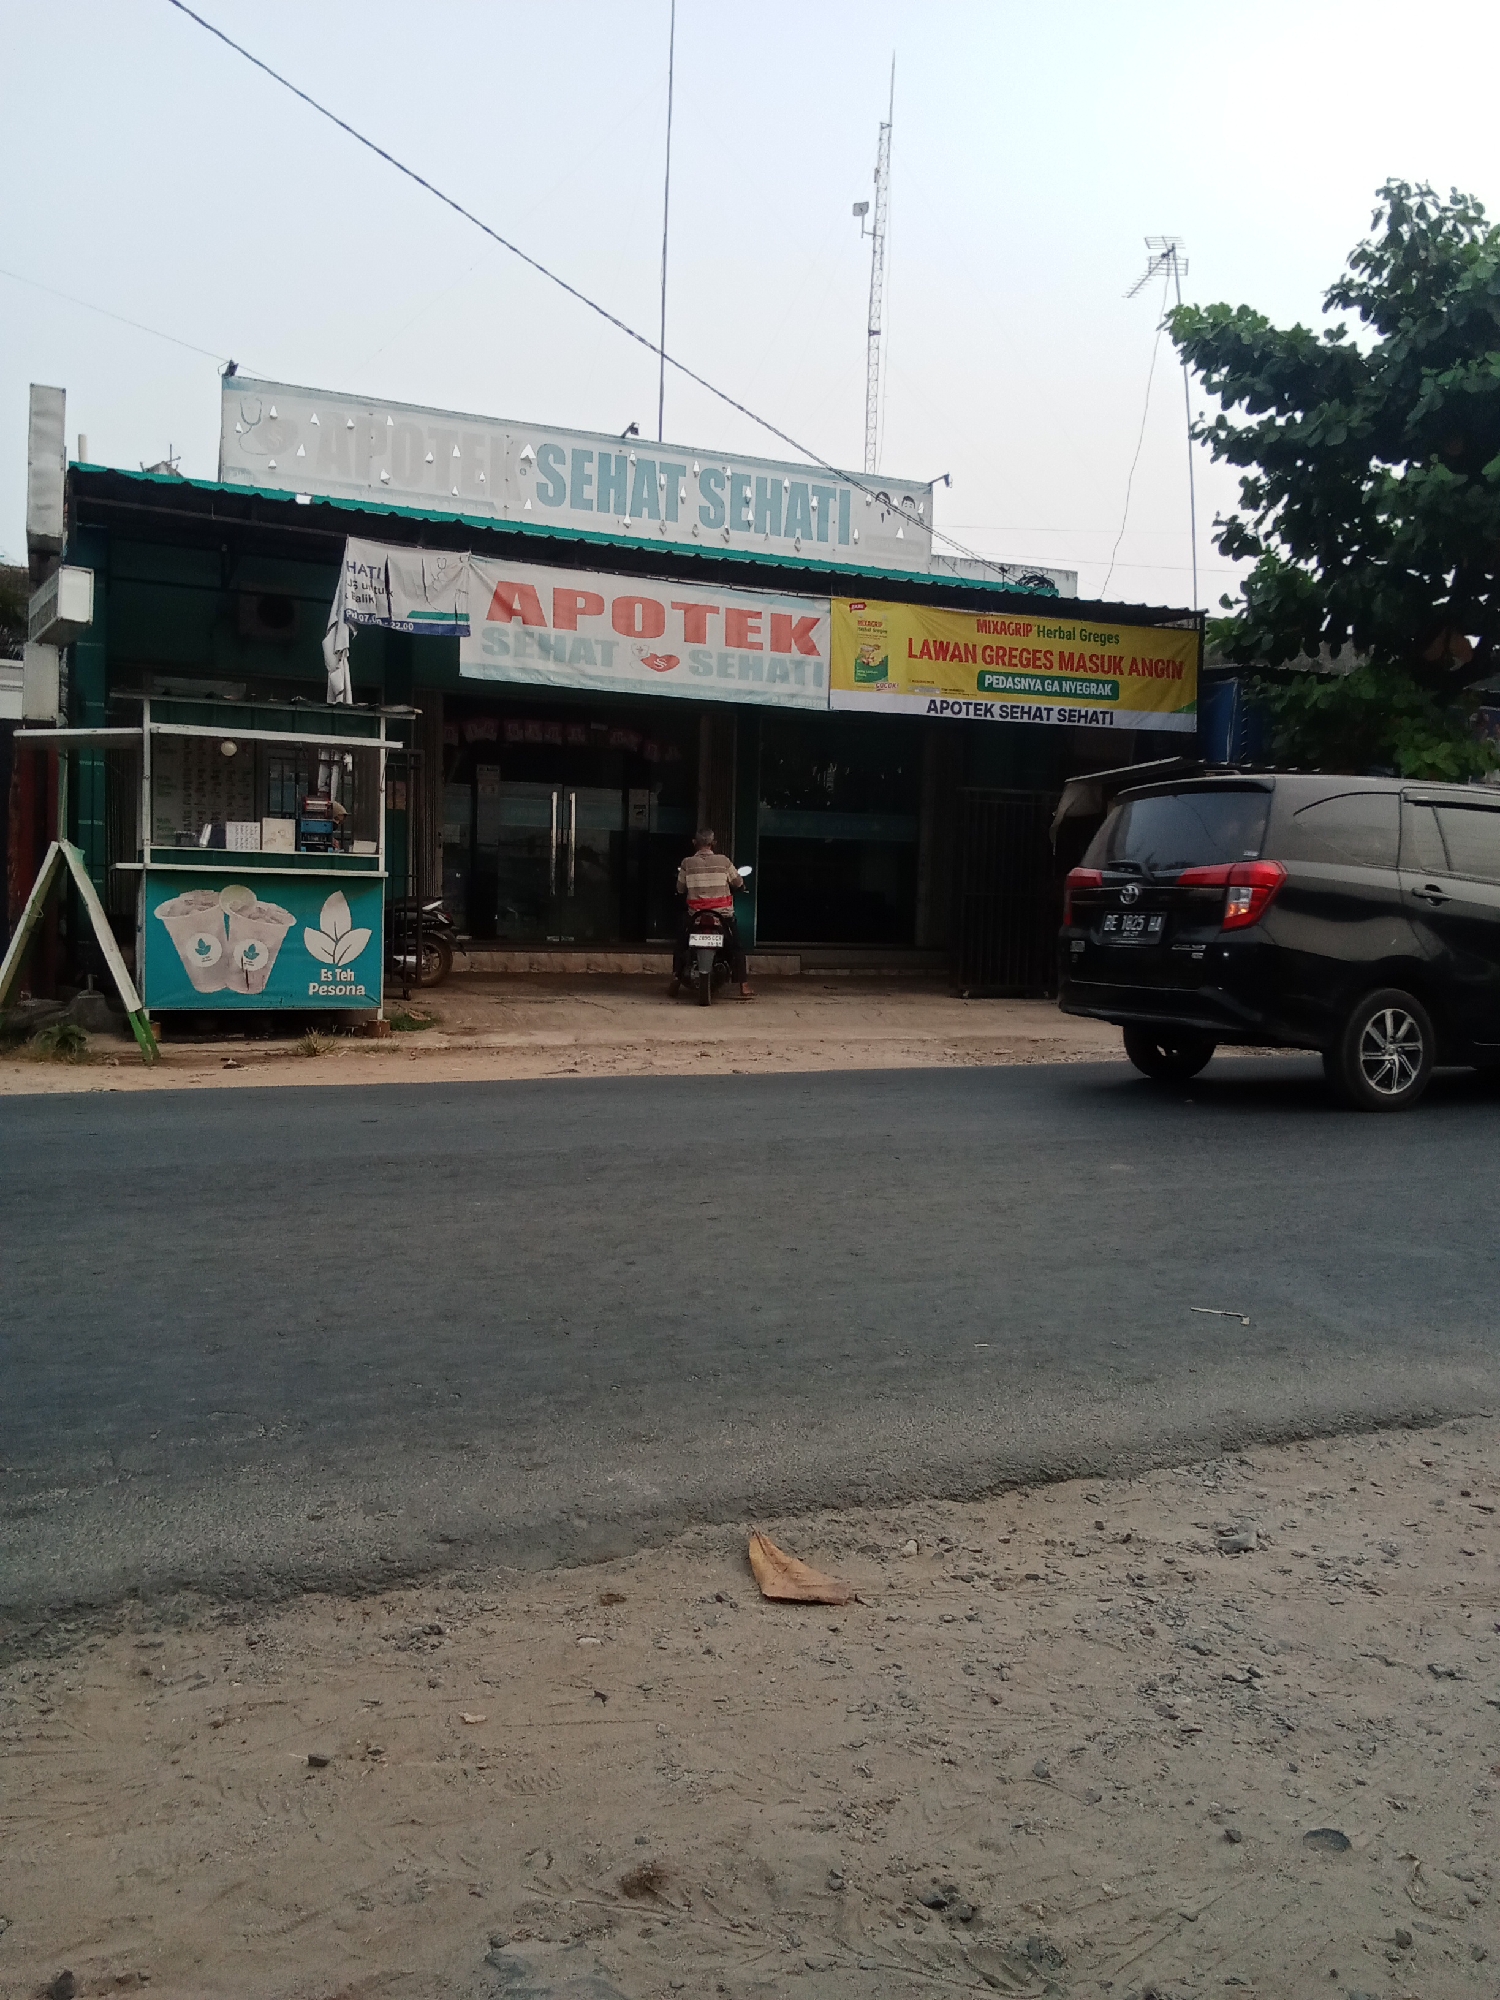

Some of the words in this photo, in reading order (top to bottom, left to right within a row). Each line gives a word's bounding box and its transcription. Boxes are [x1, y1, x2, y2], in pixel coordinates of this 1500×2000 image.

[316, 411, 525, 501] APOTEK
[536, 443, 687, 523] SEHAT
[699, 468, 851, 546] SEHATI
[391, 620, 414, 631] 22.00
[486, 580, 821, 657] APOTEK
[976, 618, 1033, 638] MIXAGRIP
[1036, 622, 1076, 642] Herbal
[1079, 629, 1120, 646] Greges
[481, 626, 620, 668] SEHAT
[688, 649, 825, 689] SEHATI
[907, 637, 979, 665] LAWAN
[981, 644, 1055, 672] GREGES
[1058, 651, 1125, 676] MASUK
[1128, 657, 1185, 681] ANGIN
[984, 674, 1043, 692] PEDASNYA
[1045, 679, 1060, 693] GA
[1062, 680, 1113, 697] NYEGRAK
[926, 698, 995, 719] APOTEK
[998, 704, 1054, 724] SEHAT
[1057, 707, 1114, 727] SEHATI
[308, 982, 366, 996] Pesona
[320, 968, 333, 982] Es
[335, 968, 355, 982] Teh
